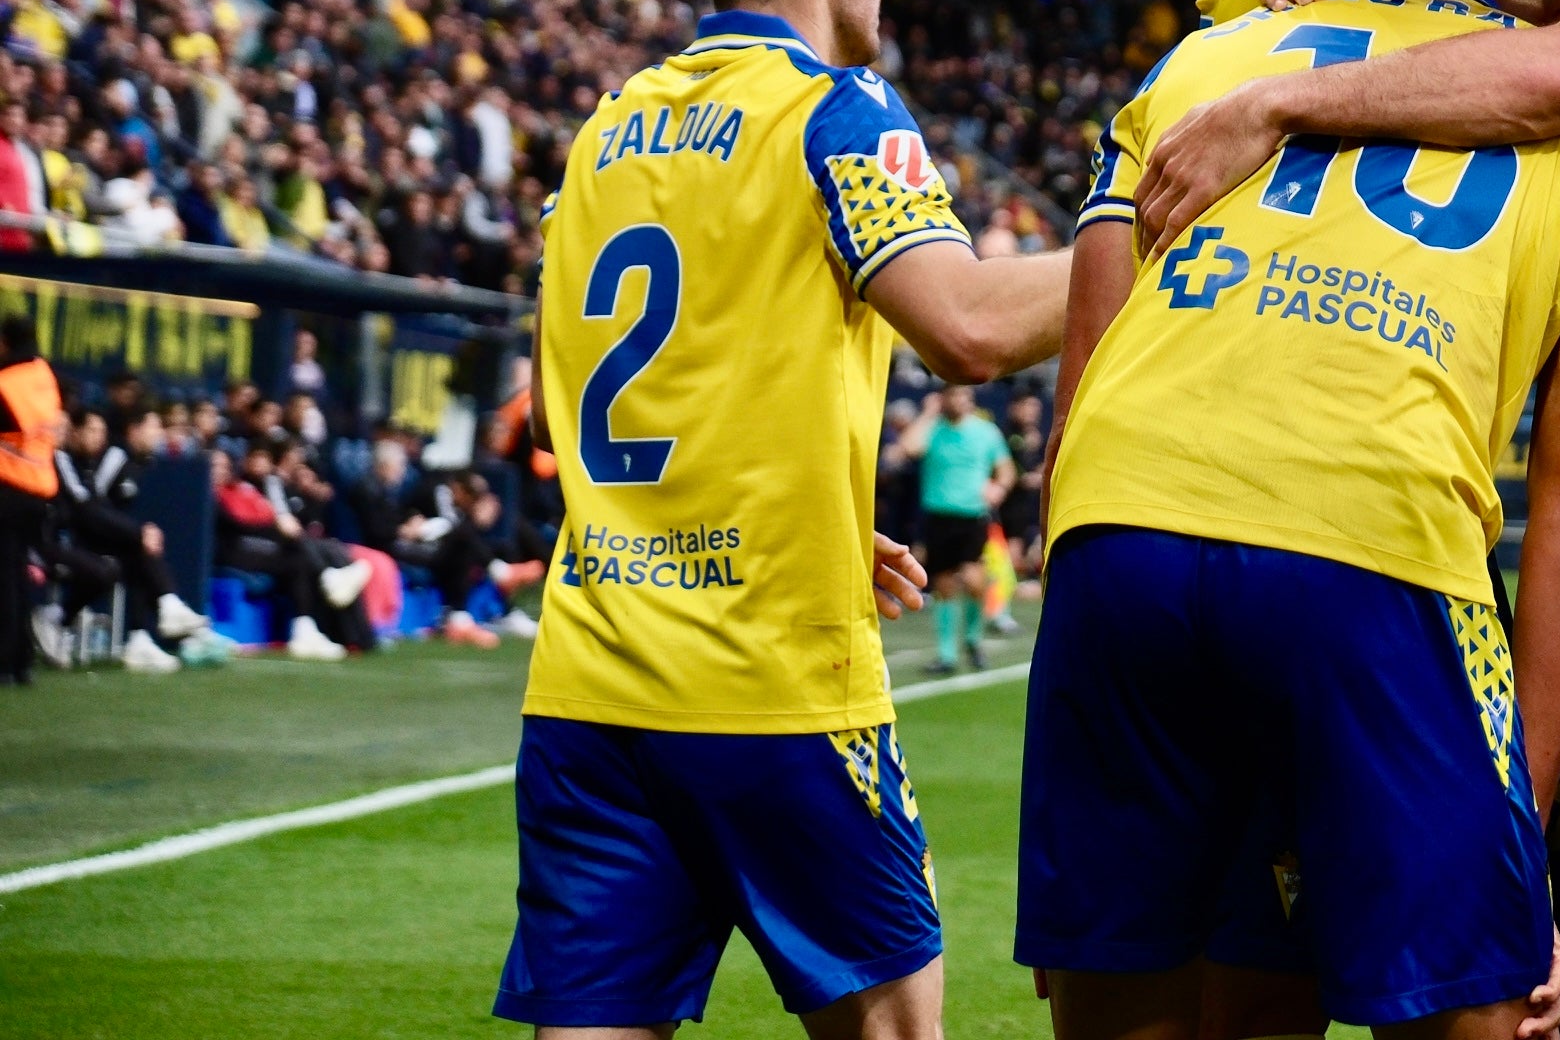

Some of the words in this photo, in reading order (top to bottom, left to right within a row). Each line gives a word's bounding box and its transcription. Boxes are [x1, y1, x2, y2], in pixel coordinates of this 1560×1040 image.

[595, 101, 744, 172] ZALDUA
[1256, 285, 1448, 373] PASCUAL
[1266, 252, 1456, 343] Hospitales
[579, 223, 683, 486] 2
[583, 523, 740, 561] Hospitales
[583, 556, 744, 590] PASCUAL
